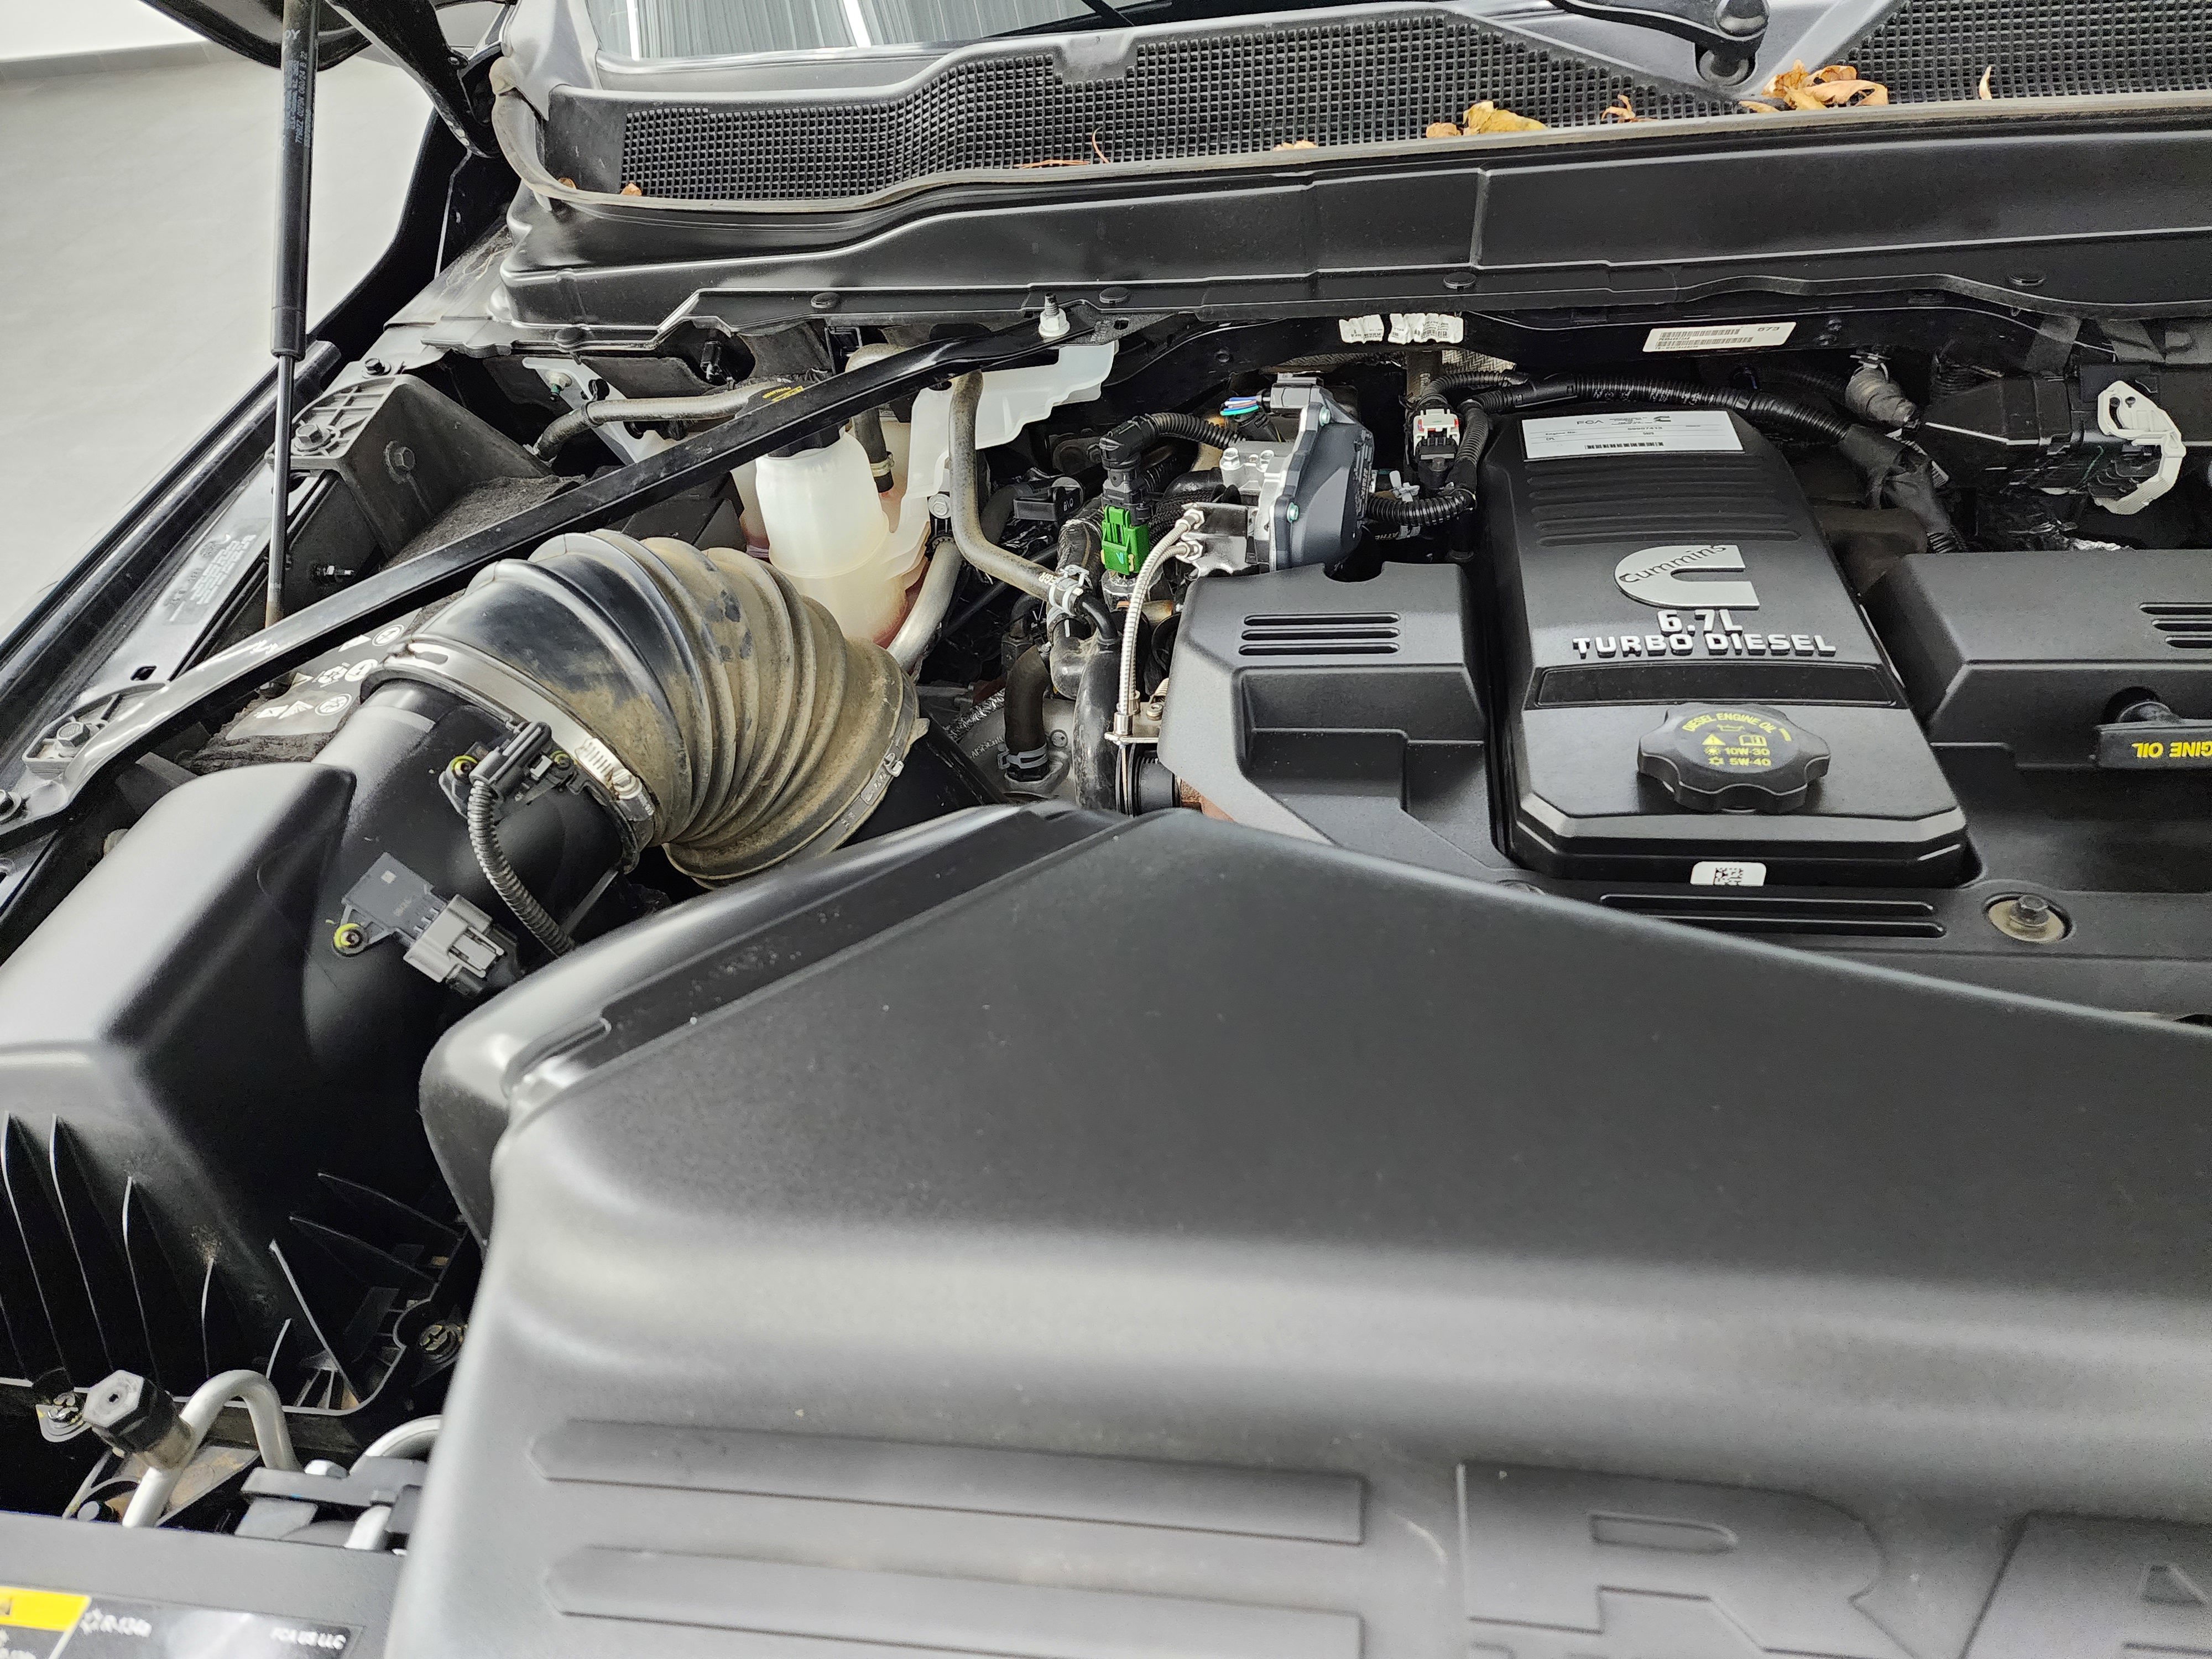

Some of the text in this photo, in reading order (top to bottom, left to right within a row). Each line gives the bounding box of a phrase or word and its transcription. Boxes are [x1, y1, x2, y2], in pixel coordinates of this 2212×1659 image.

[1619, 544, 1727, 583] Cummins
[1657, 609, 1743, 635] 6.7L
[1572, 633, 1837, 659] TURBO DIESEL
[1682, 713, 1777, 734] DIESEL ENGINE OIL
[1725, 747, 1770, 756] 10W-30
[2131, 741, 2212, 758] OIL GINE
[1729, 757, 1771, 766] 5W-40
[1454, 1457, 2212, 1659] RA
